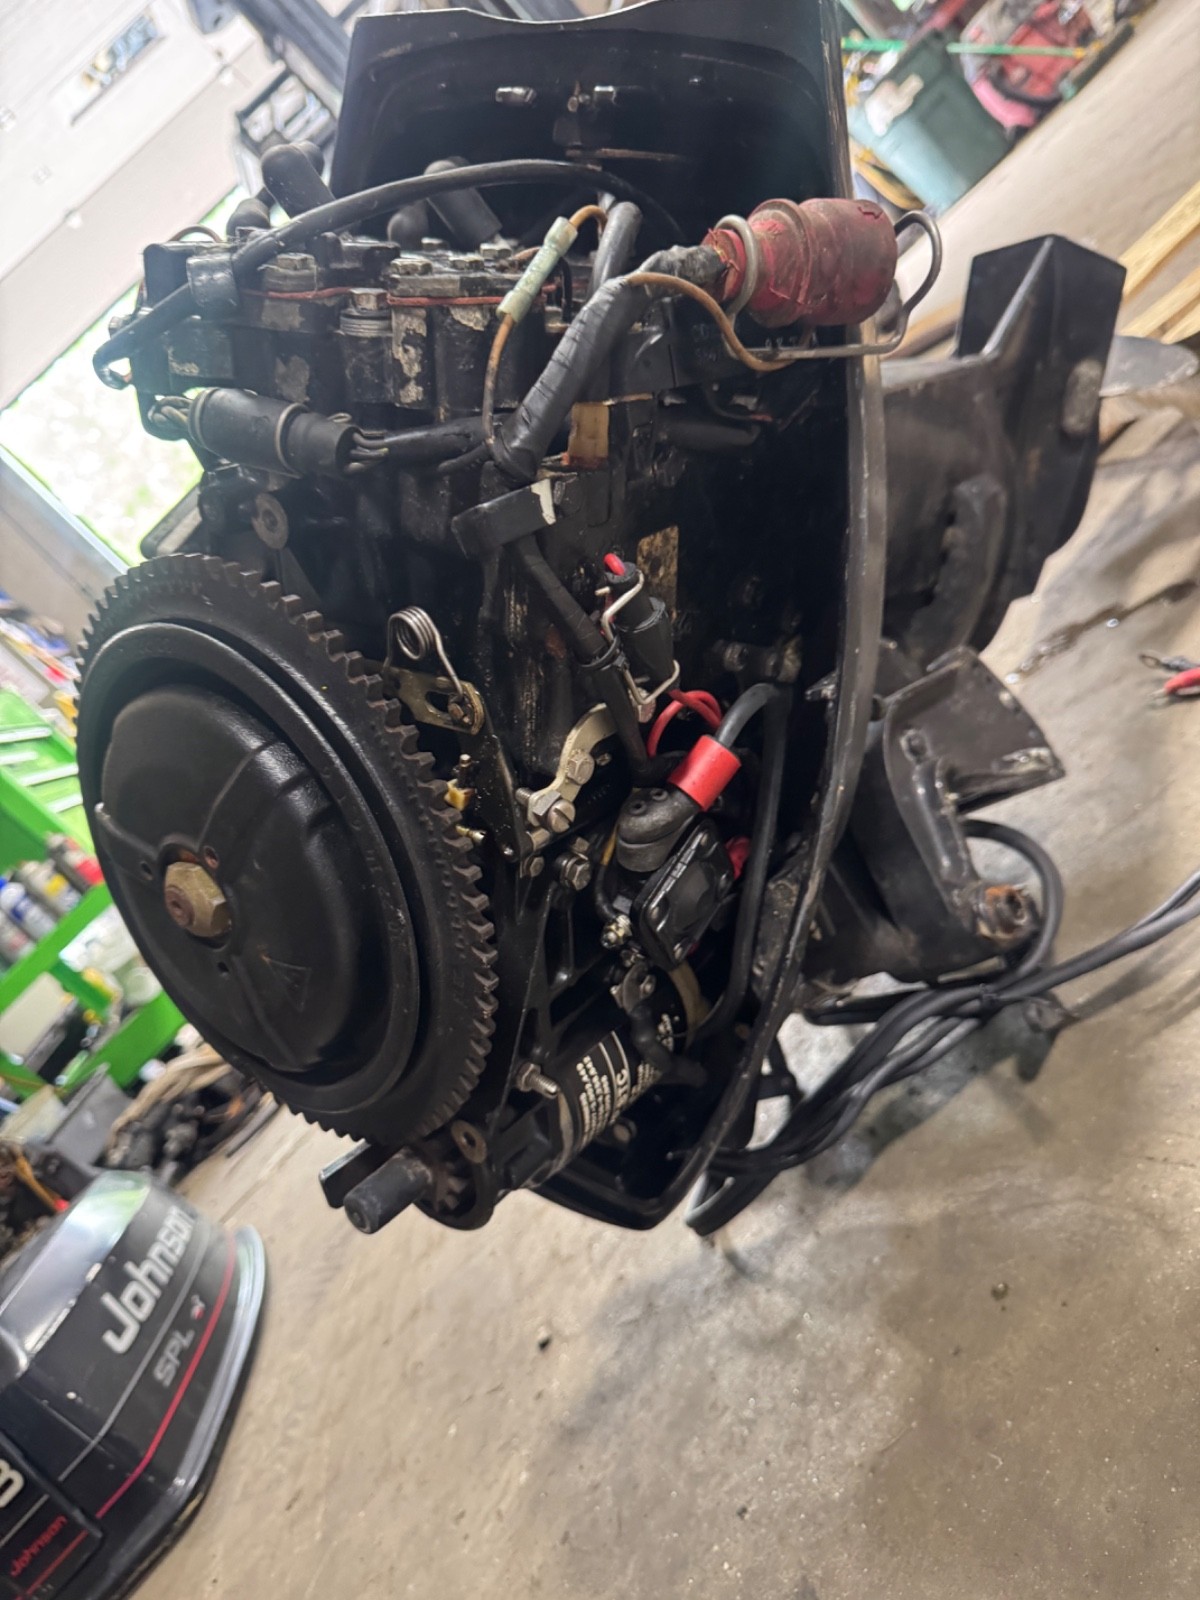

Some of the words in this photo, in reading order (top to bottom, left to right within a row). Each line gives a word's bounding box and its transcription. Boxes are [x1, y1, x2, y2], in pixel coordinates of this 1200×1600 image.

[101, 1205, 198, 1354] Johnson
[153, 1328, 195, 1388] SPL
[10, 1514, 67, 1577] Johnson
